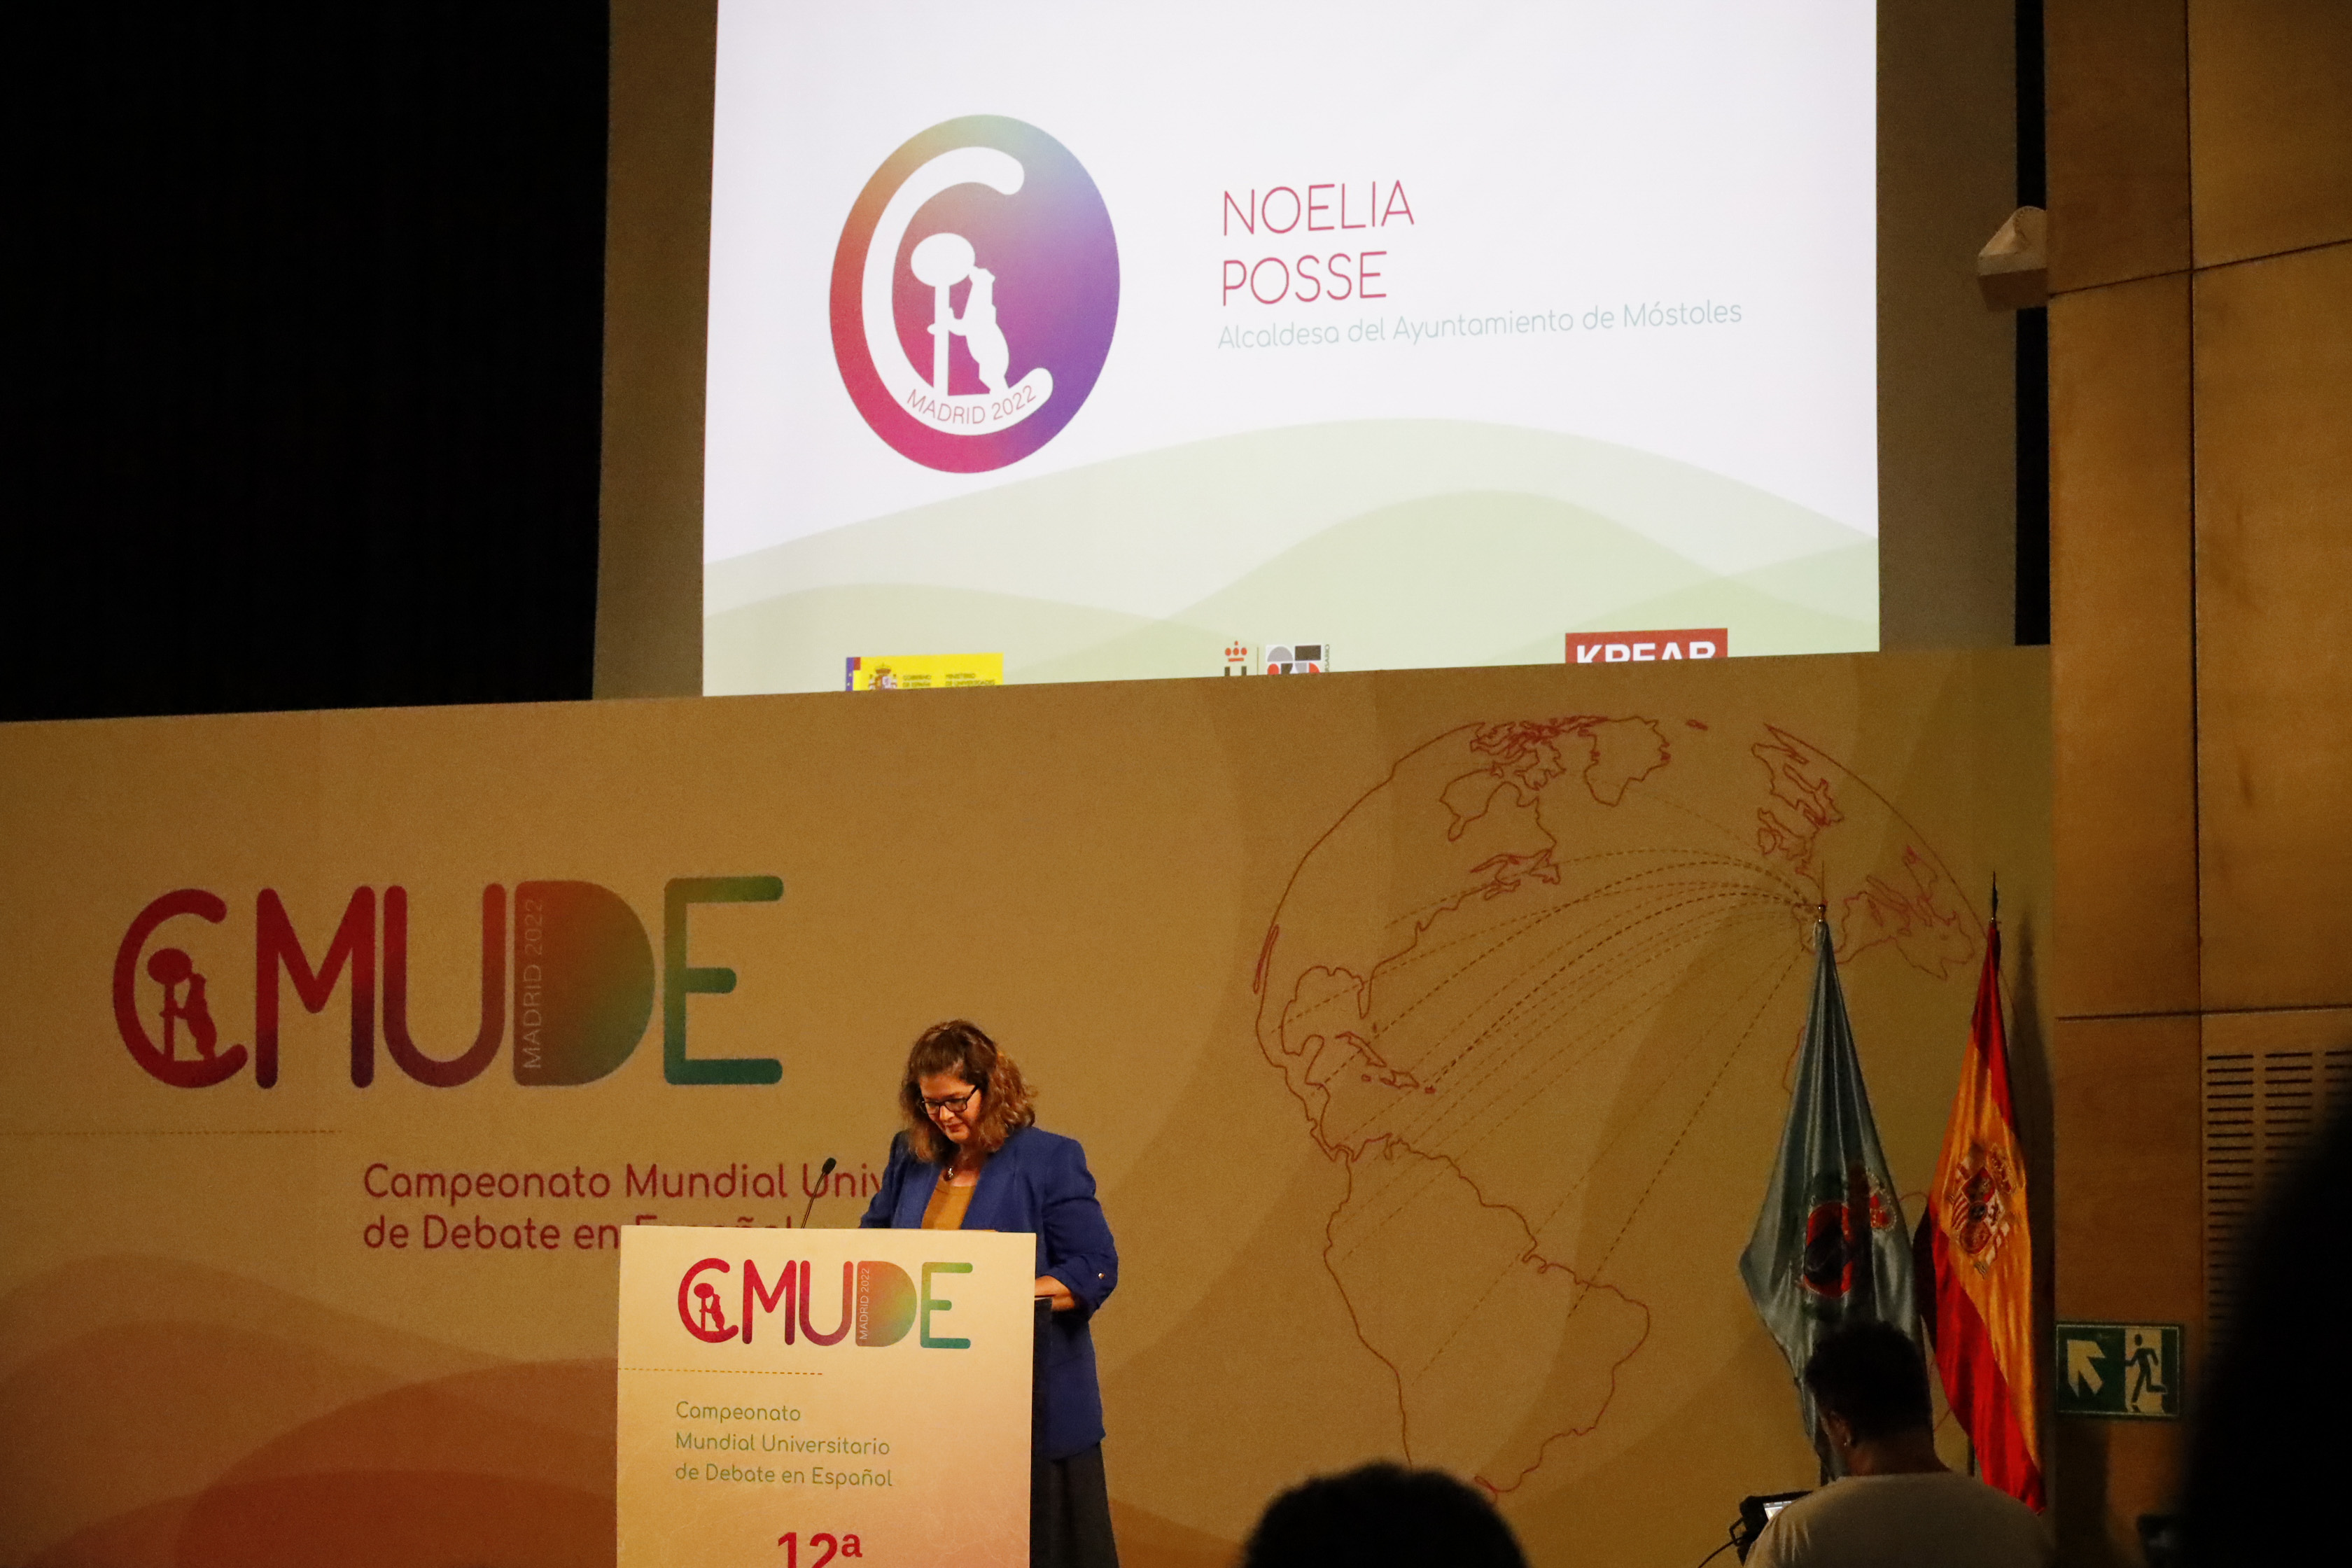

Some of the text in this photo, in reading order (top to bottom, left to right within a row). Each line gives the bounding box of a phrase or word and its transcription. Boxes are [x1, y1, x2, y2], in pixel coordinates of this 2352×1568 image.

[1224, 180, 1414, 236] NOELIA
[1223, 251, 1387, 306] POSSE
[1217, 299, 1742, 349] Alcaldesa del Ayuntamiento de Móstoles
[906, 385, 1036, 424] MADRID 2022
[522, 898, 543, 1070] MADRID 2022
[363, 1162, 610, 1208] Campeonato
[626, 1162, 788, 1198] Mundial
[363, 1214, 620, 1250] de Debate en
[678, 1257, 974, 1350] CMUDE
[859, 1268, 870, 1340] MADRID 2022
[676, 1400, 802, 1424] Campeonato
[676, 1432, 891, 1456] Mundial Universitario
[675, 1462, 893, 1490] de Debate en Español
